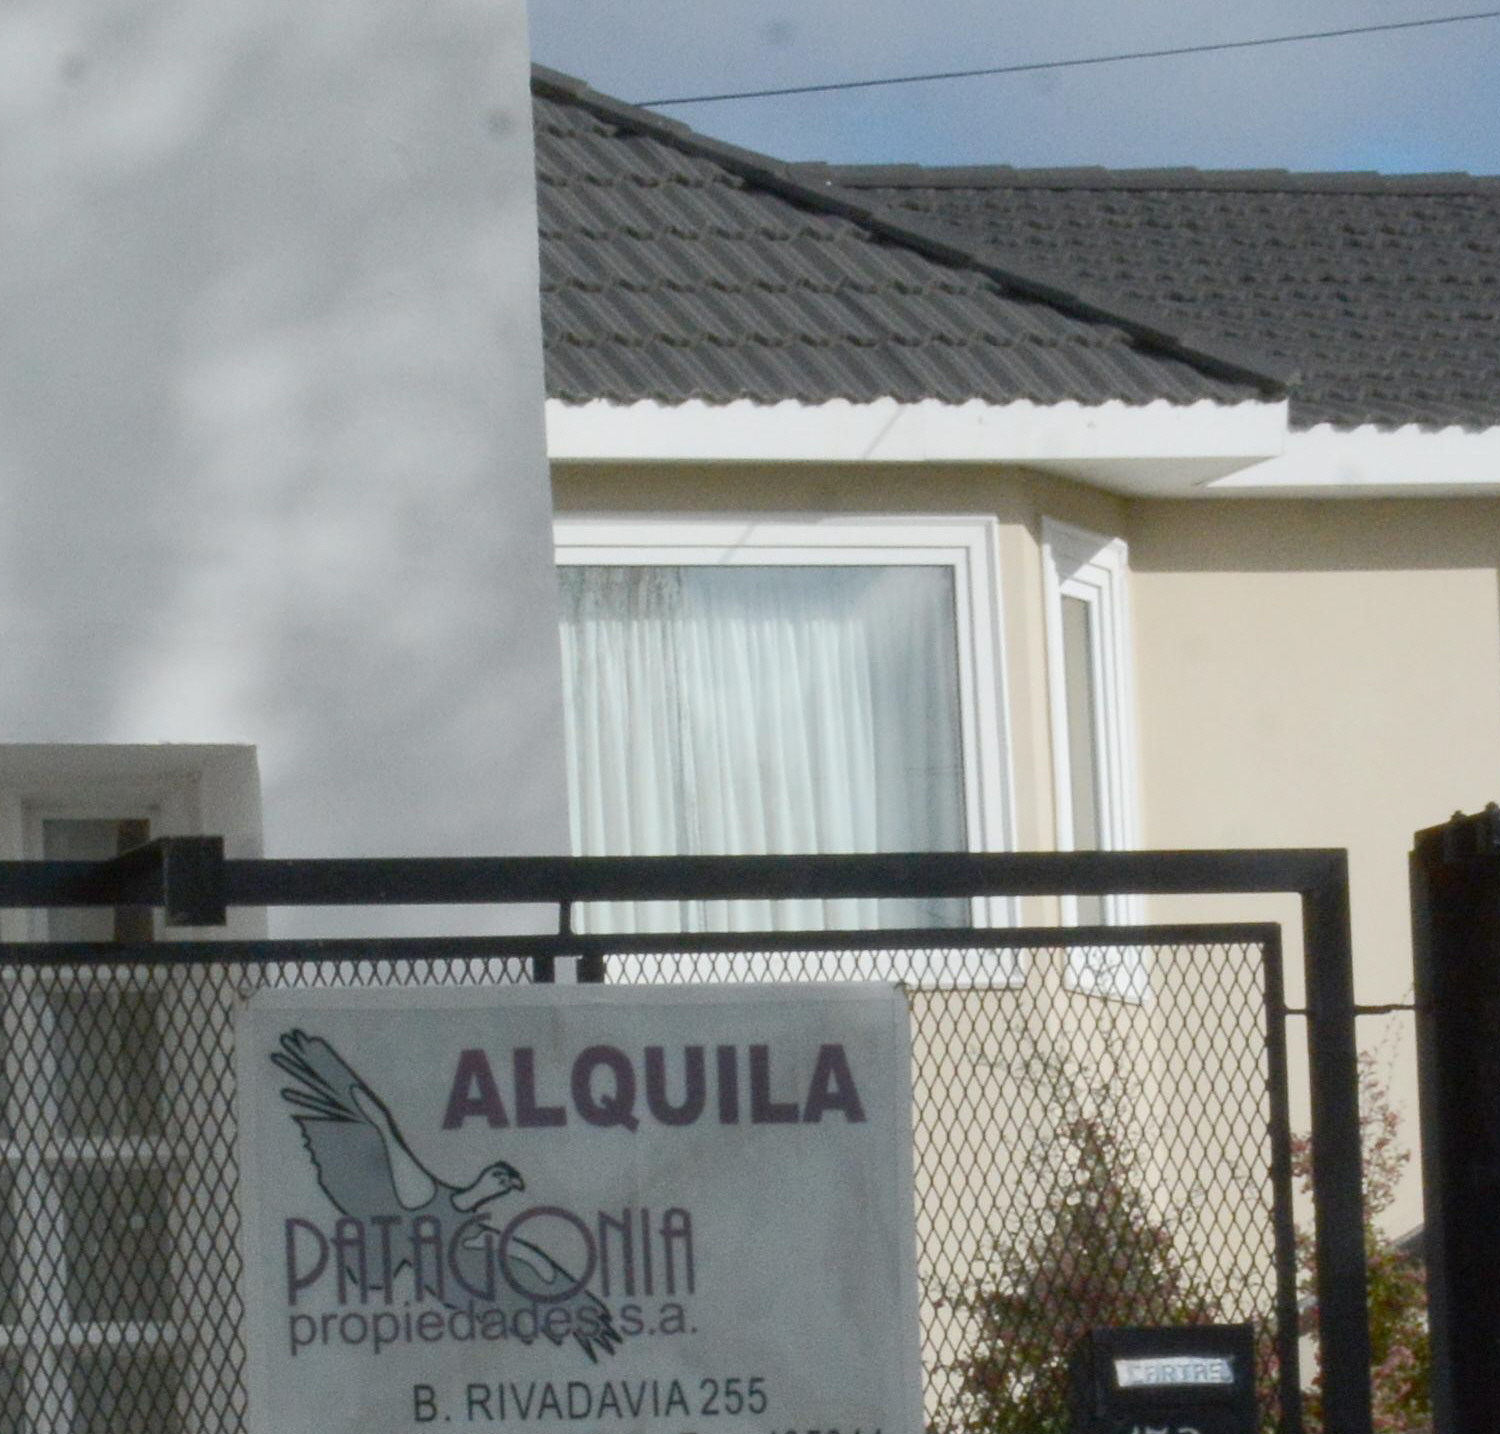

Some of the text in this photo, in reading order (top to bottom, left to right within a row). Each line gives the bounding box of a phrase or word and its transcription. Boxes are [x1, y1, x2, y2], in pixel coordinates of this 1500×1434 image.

[440, 1042, 868, 1134] ALQUILA
[284, 1205, 698, 1306] PATAGONIA
[288, 1302, 600, 1357] propiedades
[412, 1377, 769, 1423] B. RIVADAVIA 255
